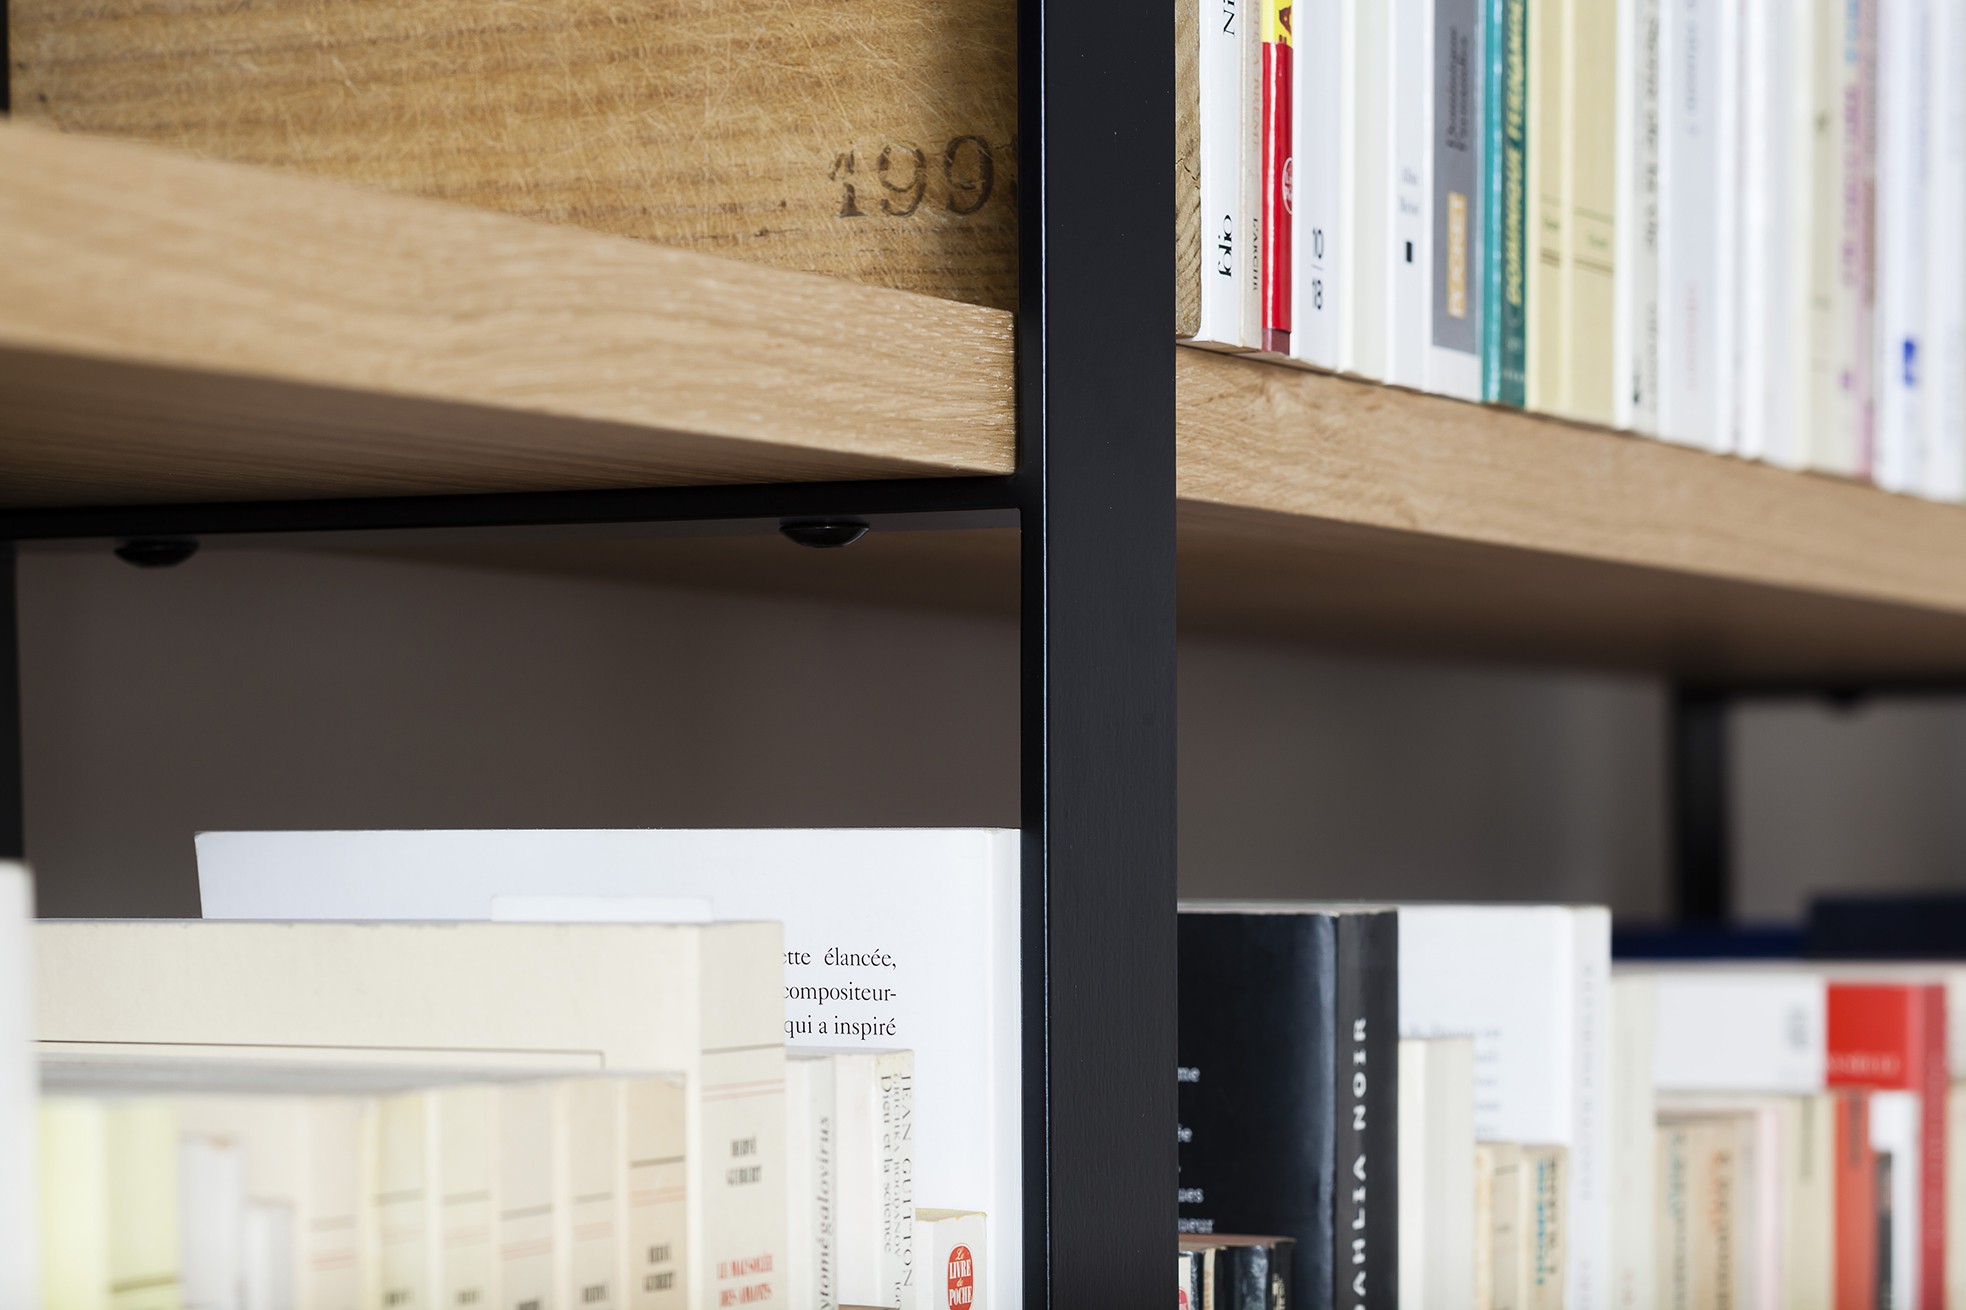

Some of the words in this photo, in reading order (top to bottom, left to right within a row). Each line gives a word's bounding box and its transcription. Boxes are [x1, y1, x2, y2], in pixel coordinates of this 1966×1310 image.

[1218, 214, 1233, 278] folio
[824, 947, 897, 971] élancée,
[783, 1014, 813, 1039] qui
[818, 1020, 828, 1035] a
[834, 1015, 897, 1041] inspiré
[1351, 1018, 1367, 1132] NOIR
[880, 1076, 892, 1124] Dieu
[900, 1076, 912, 1141] JEAN
[882, 1133, 892, 1149] et
[883, 1158, 894, 1173] la
[882, 1182, 892, 1254] science
[901, 1158, 913, 1287] GUITTON
[1351, 1154, 1367, 1310] AHLIA
[954, 1246, 965, 1261] Le
[949, 1258, 972, 1280] LIVRE
[955, 1277, 964, 1288] de
[949, 1285, 973, 1306] POCHE
